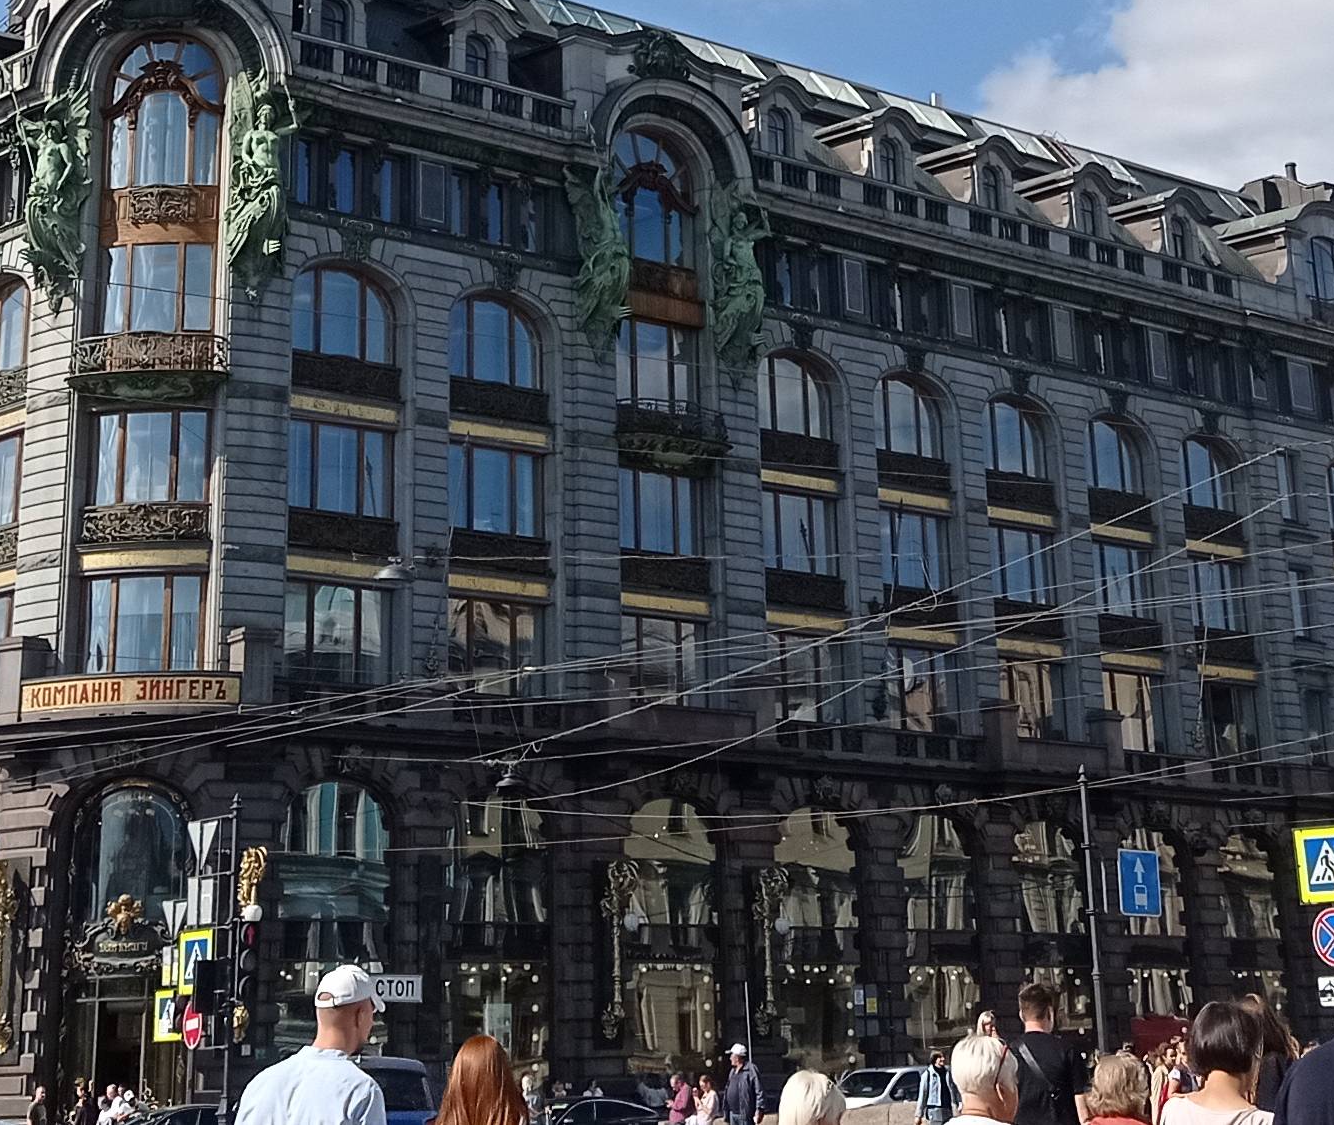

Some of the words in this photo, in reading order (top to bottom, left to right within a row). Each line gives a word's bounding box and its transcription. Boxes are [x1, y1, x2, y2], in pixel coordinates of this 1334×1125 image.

[30, 681, 122, 708] КОМПАНІЯ
[136, 678, 227, 702] ЗИНГЕРЪ
[375, 979, 415, 997] СТОП
